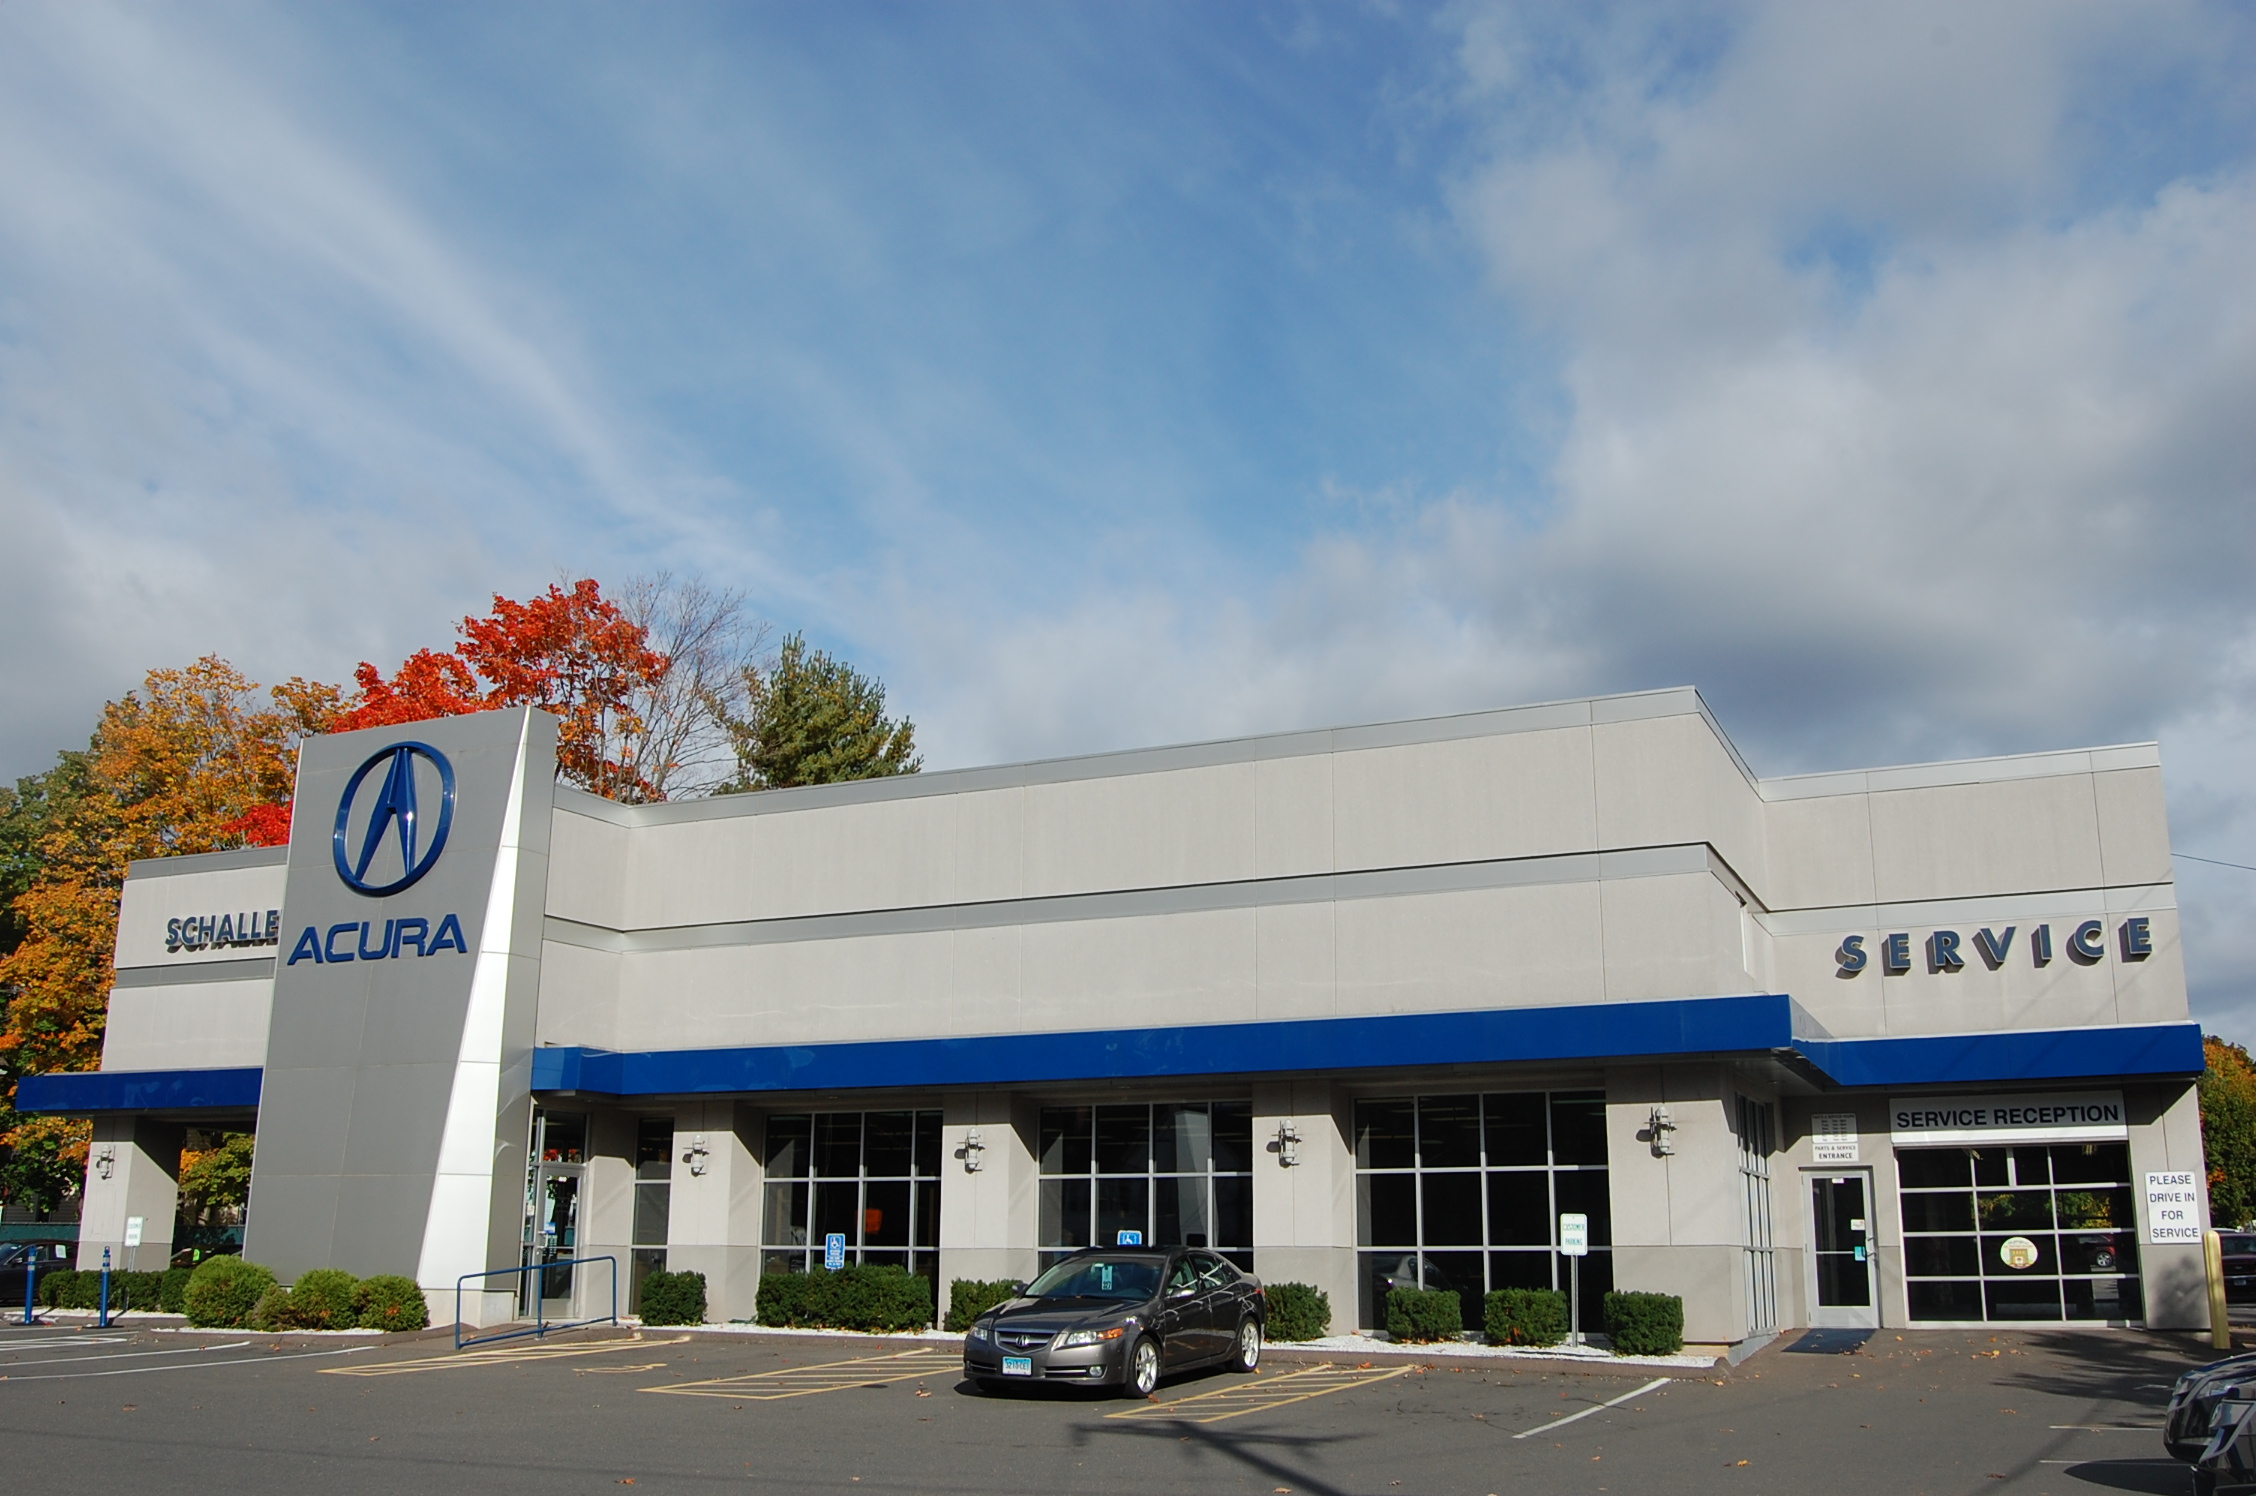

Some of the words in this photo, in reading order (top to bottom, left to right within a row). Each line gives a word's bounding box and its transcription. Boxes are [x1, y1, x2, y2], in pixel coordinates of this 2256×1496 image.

[165, 909, 280, 946] SCHALLE
[287, 913, 468, 966] ACURA
[1841, 916, 2153, 972] SERVICE
[1896, 1109, 1987, 1128] SERVICE
[1994, 1104, 2119, 1125] RECEPTION
[2149, 1175, 2192, 1185] PLEASE
[2149, 1192, 2182, 1203] DRIVE
[2184, 1192, 2195, 1202] IN
[2161, 1210, 2184, 1220] FOR
[2152, 1227, 2199, 1238] SERVICE
